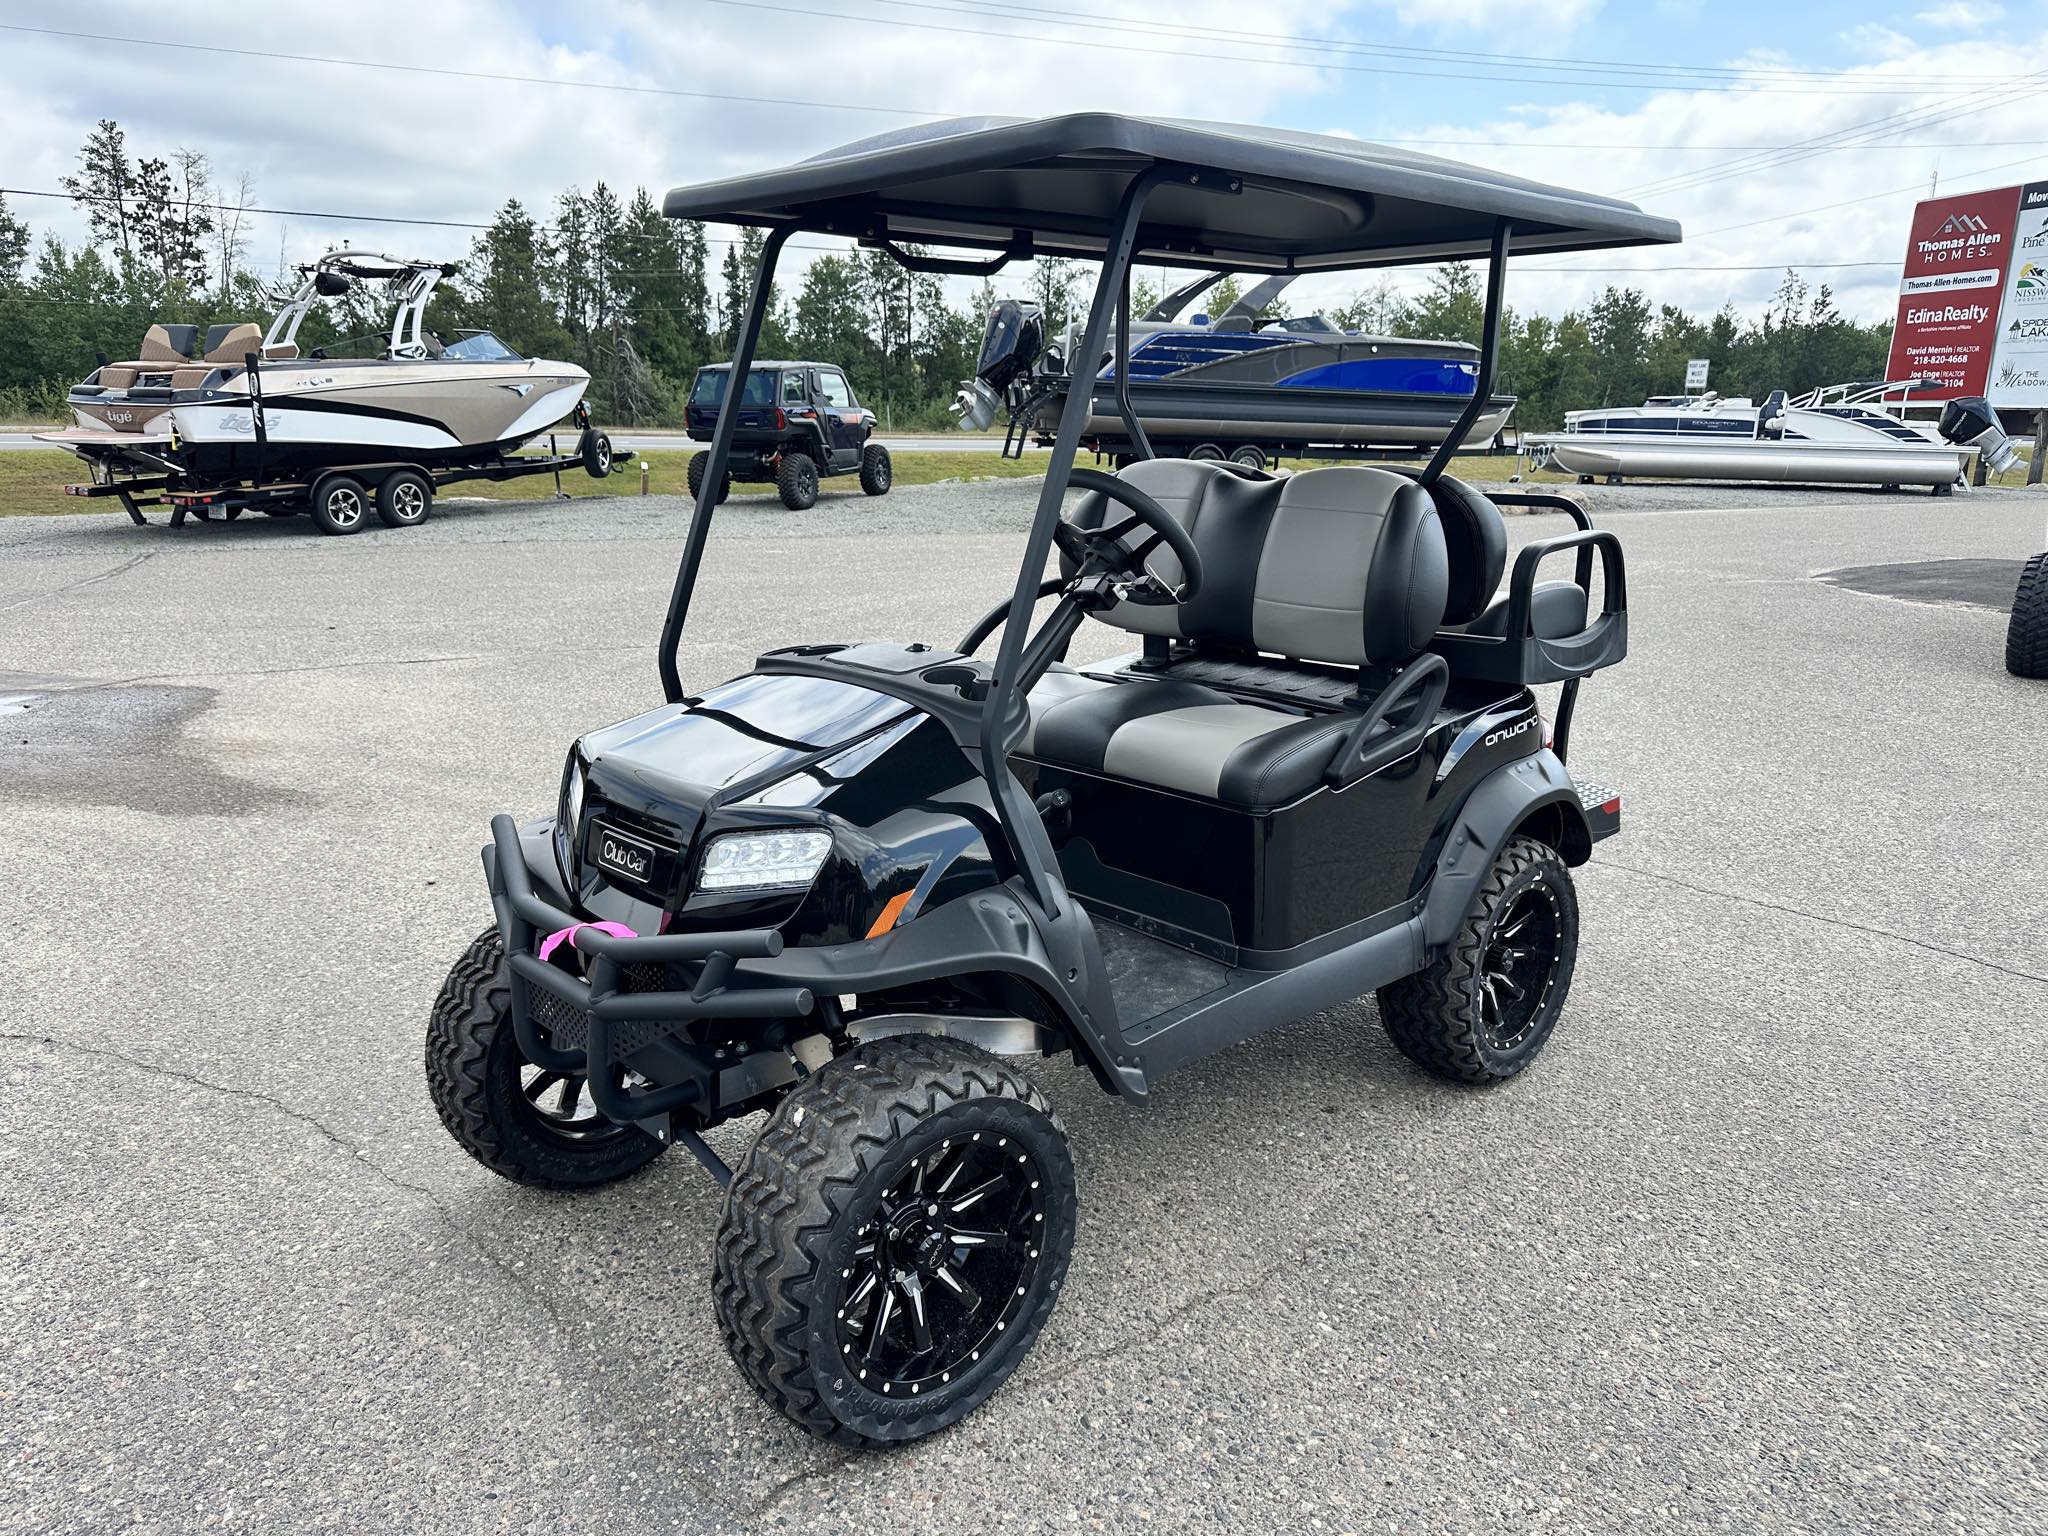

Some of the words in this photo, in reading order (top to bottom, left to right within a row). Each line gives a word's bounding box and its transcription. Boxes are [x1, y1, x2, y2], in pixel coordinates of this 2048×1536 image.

[2027, 192, 2048, 204] Mov
[1918, 238, 1965, 253] Thomas
[1966, 233, 2001, 247] Allen
[2022, 236, 2045, 249] Pine
[1924, 246, 1987, 263] HOMES
[1908, 274, 1992, 290] Thomas-Allen-Homes.com
[2021, 326, 2048, 338] LAK
[1906, 346, 1927, 355] David
[1927, 345, 1953, 354] Mernin
[1956, 345, 1980, 353] REALTOR
[1913, 354, 1968, 365] 218-820-4668
[1909, 370, 1921, 379] Joe
[1922, 369, 1940, 379] Enge
[2025, 370, 2040, 378] THE
[106, 410, 132, 424] tigé
[1950, 411, 1968, 434] MERCURY
[604, 840, 627, 865] Club
[627, 850, 647, 872] Car
